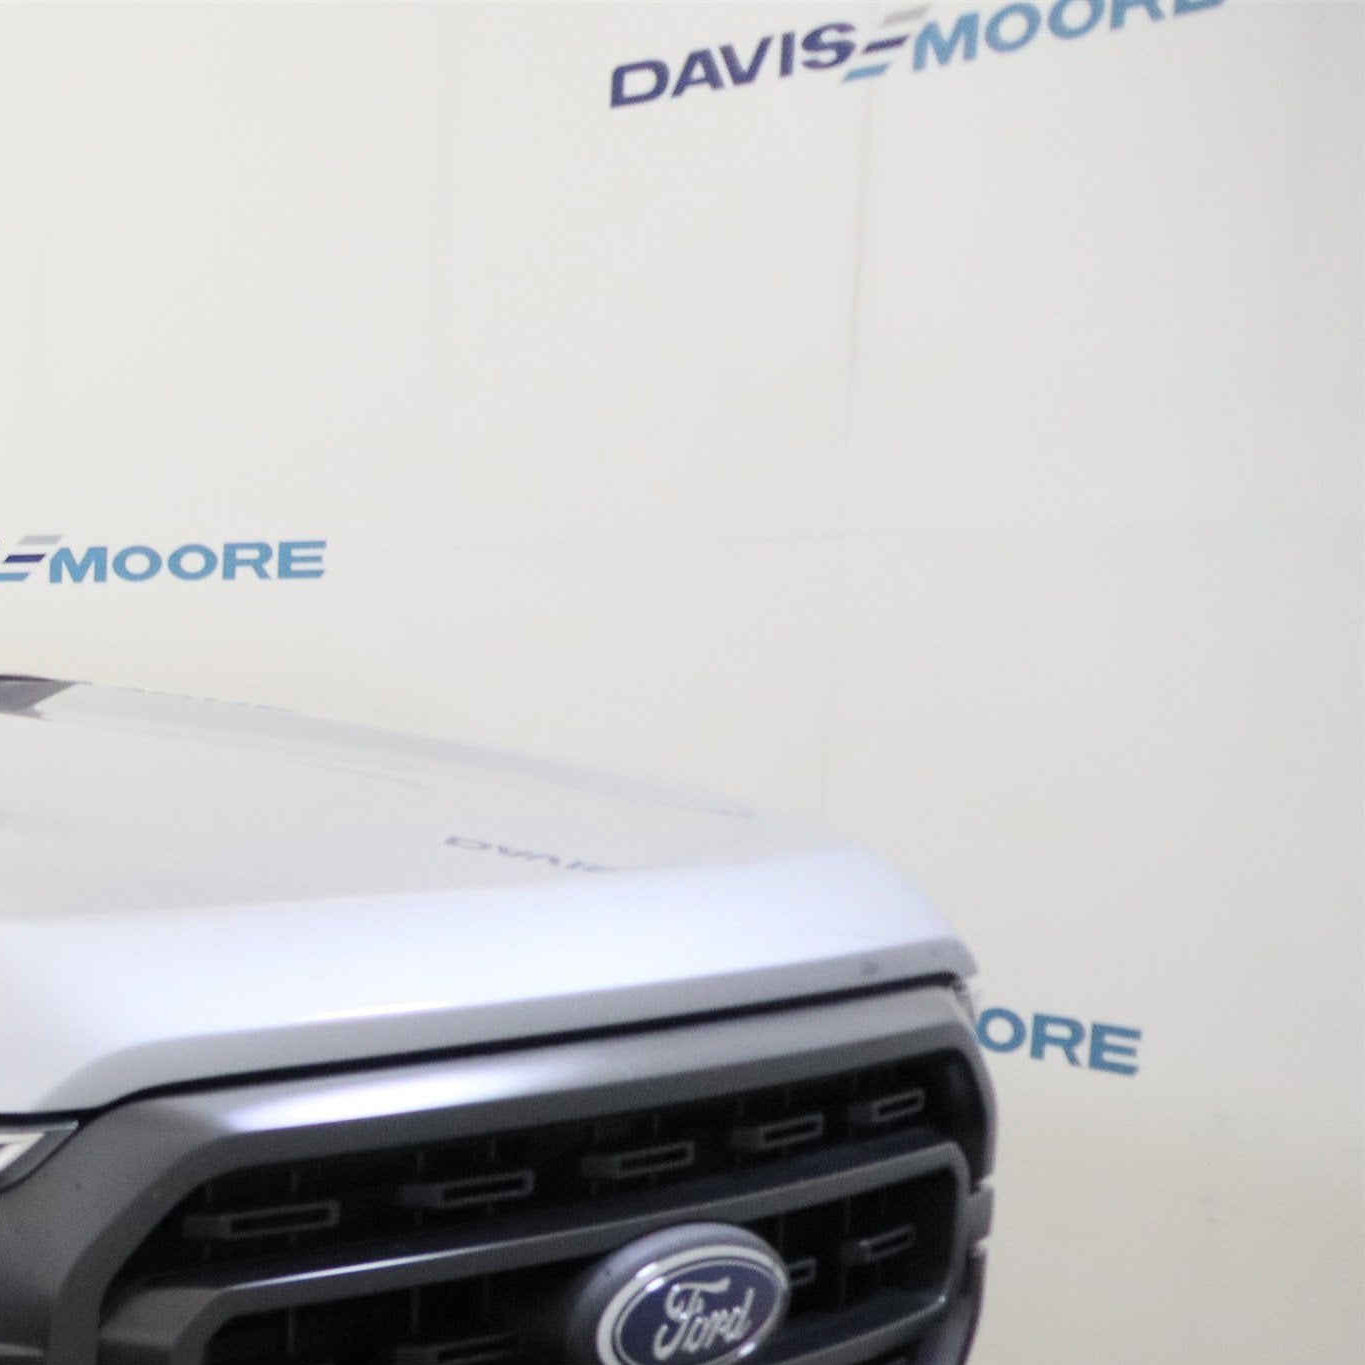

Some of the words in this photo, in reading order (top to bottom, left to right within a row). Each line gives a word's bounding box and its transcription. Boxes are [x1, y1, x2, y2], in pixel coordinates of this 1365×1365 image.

[609, 22, 857, 109] DAVIS
[49, 540, 327, 583] MOORE
[975, 1006, 1143, 1077] ORE
[652, 1276, 756, 1361] Ford
